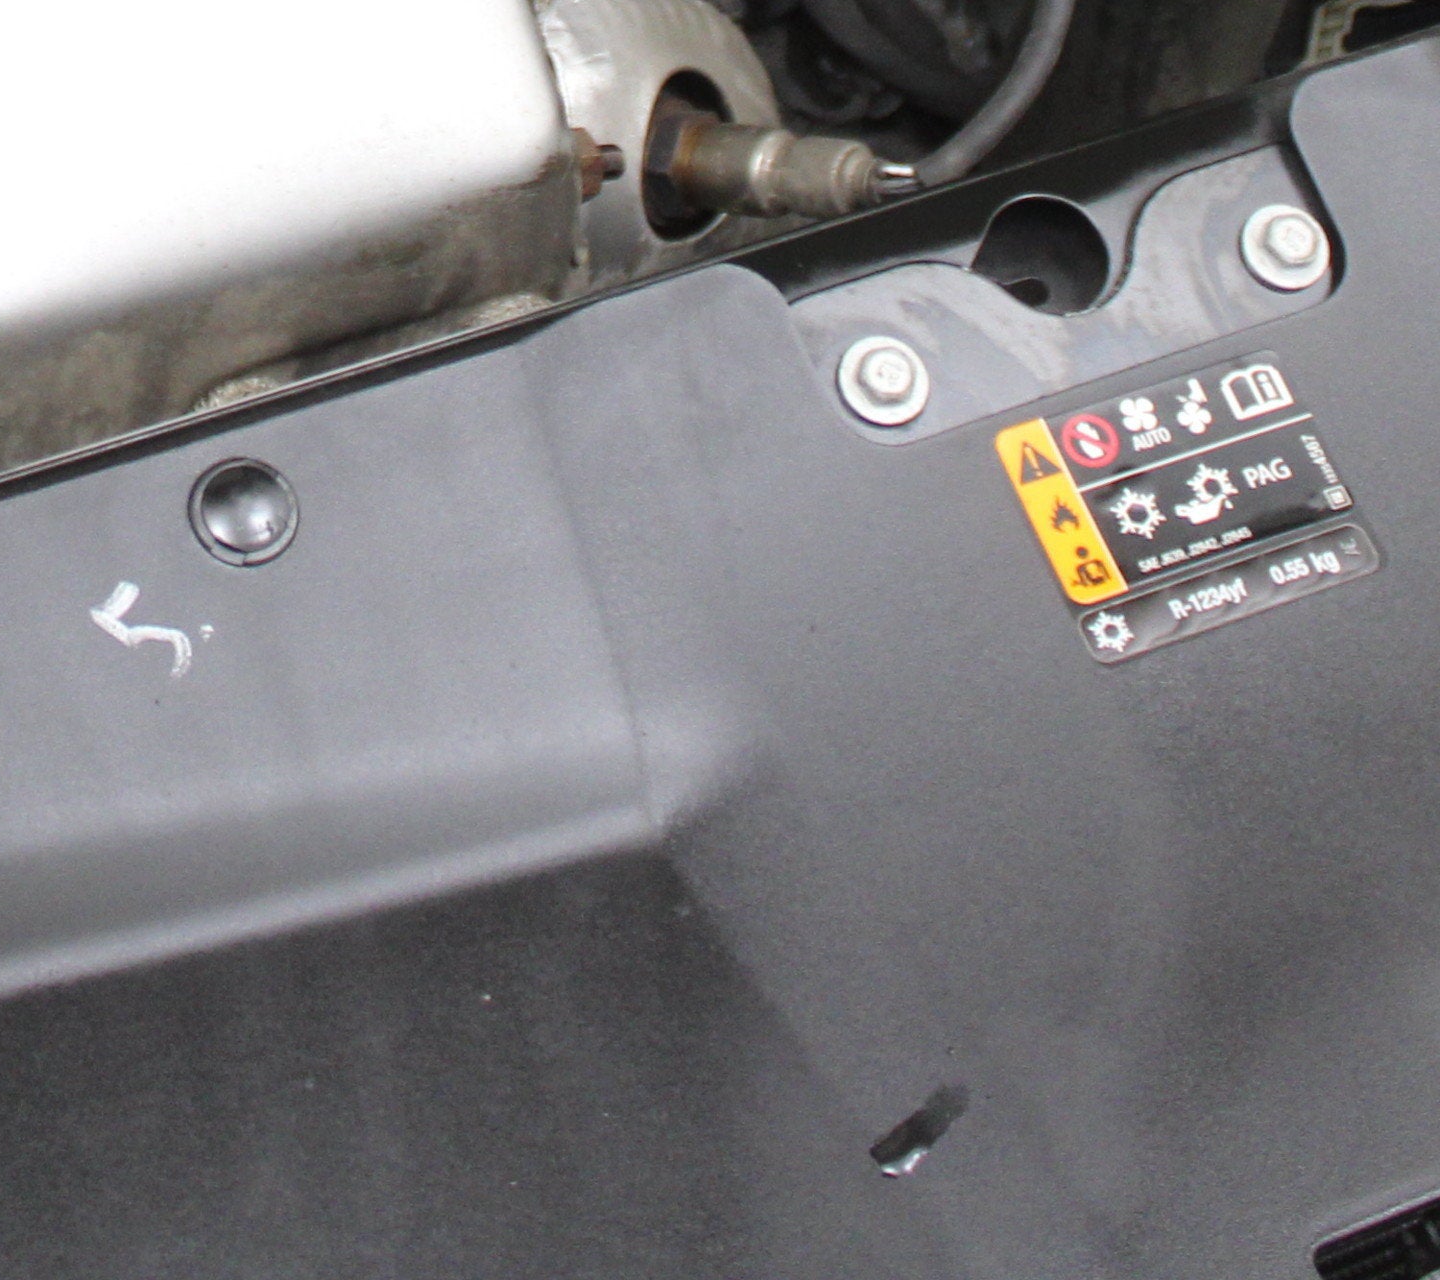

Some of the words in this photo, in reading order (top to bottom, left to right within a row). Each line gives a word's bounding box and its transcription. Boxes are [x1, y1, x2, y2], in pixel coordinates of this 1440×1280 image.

[1132, 426, 1172, 452] AUTO
[1241, 457, 1292, 489] PAG
[1167, 577, 1247, 619] R-1234yf
[1269, 557, 1310, 585] 0.55
[1308, 550, 1341, 574] kg
